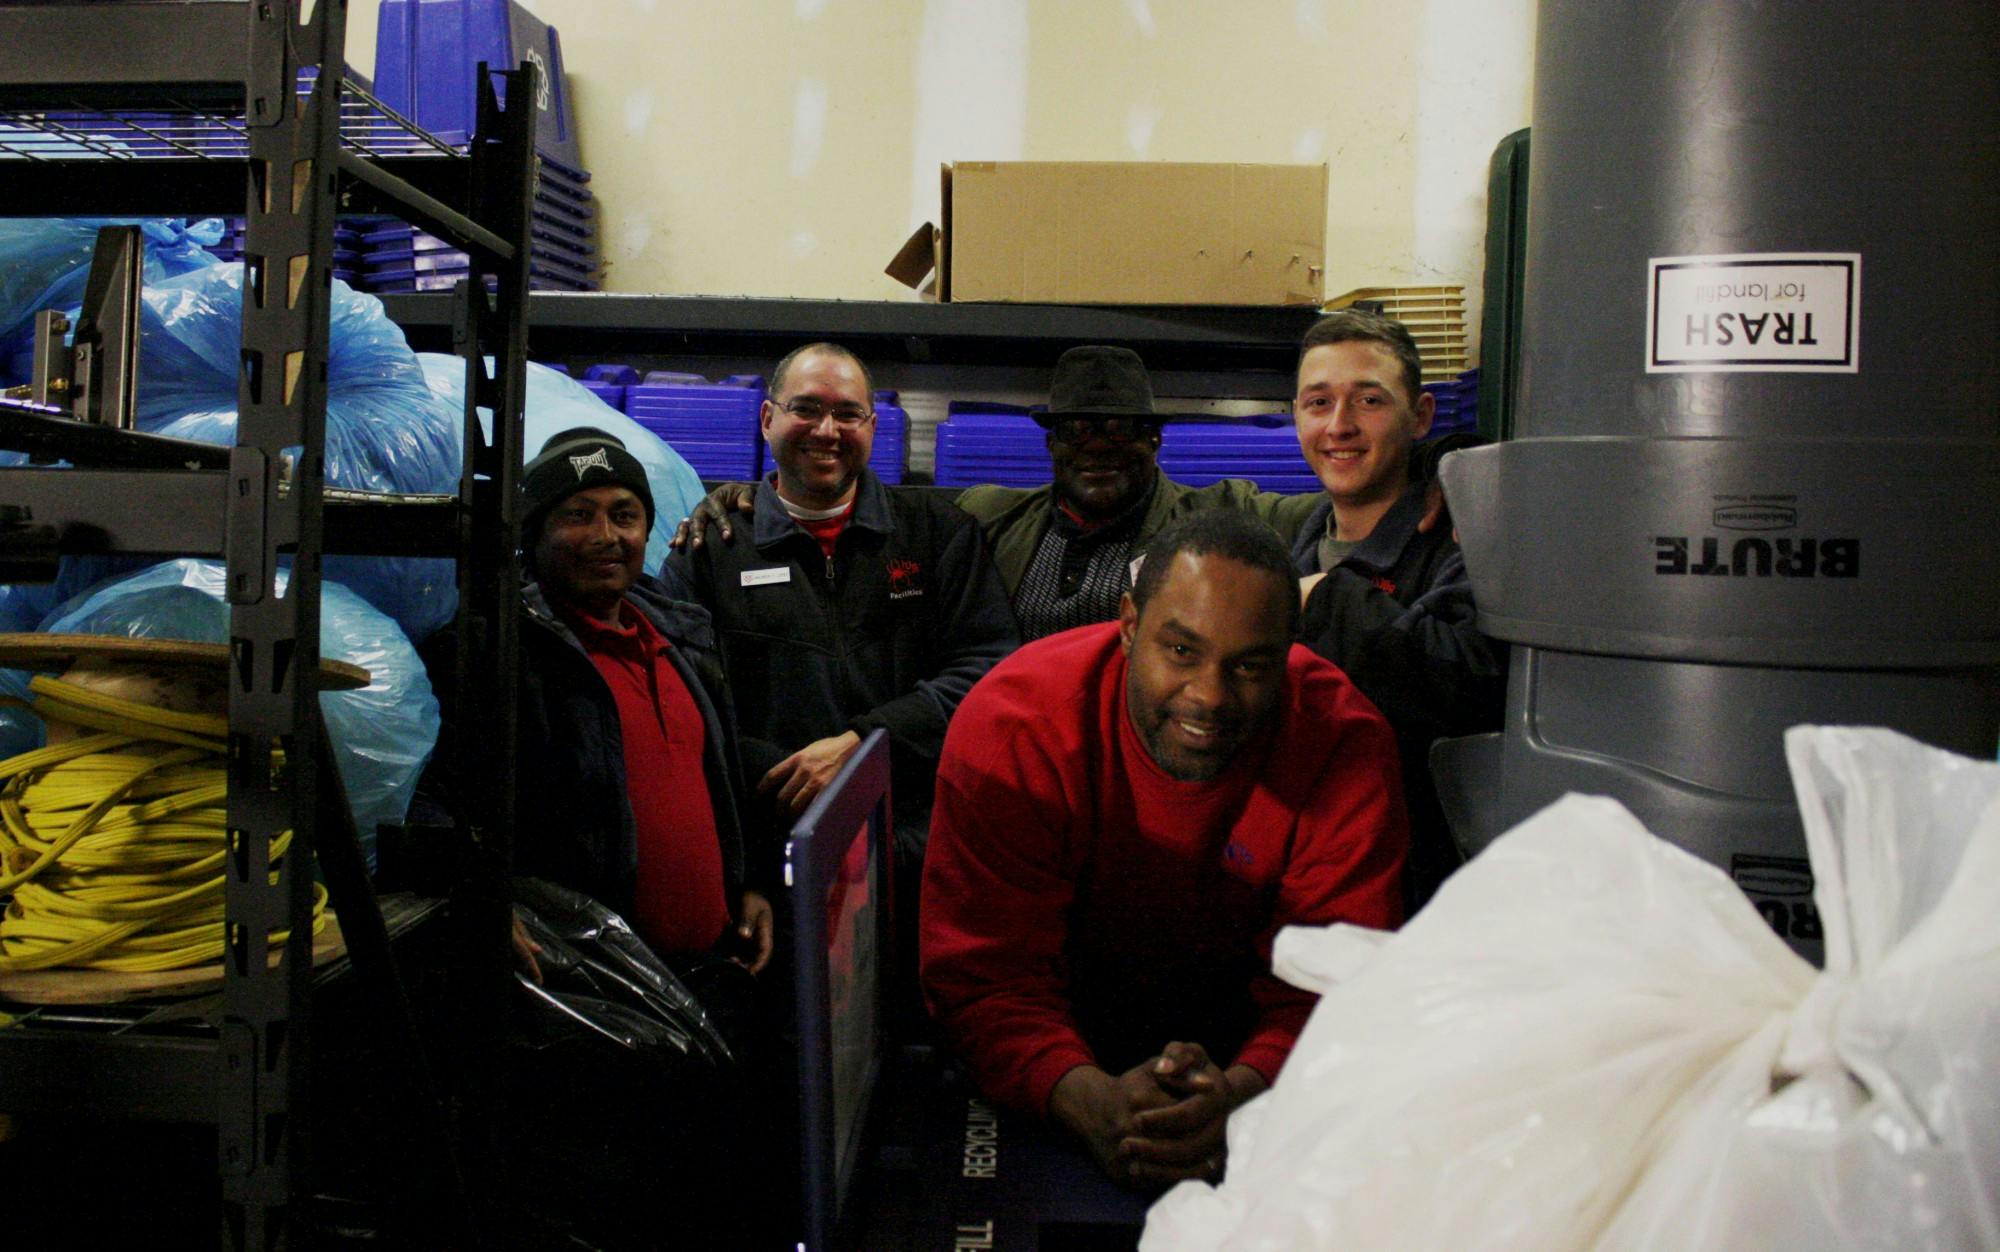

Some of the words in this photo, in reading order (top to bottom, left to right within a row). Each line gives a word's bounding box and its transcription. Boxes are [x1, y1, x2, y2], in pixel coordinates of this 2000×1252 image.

[1696, 283, 1769, 303] landfill
[1775, 283, 1806, 302] for
[1686, 312, 1818, 346] TRASH
[1655, 536, 1860, 578] BRUTE
